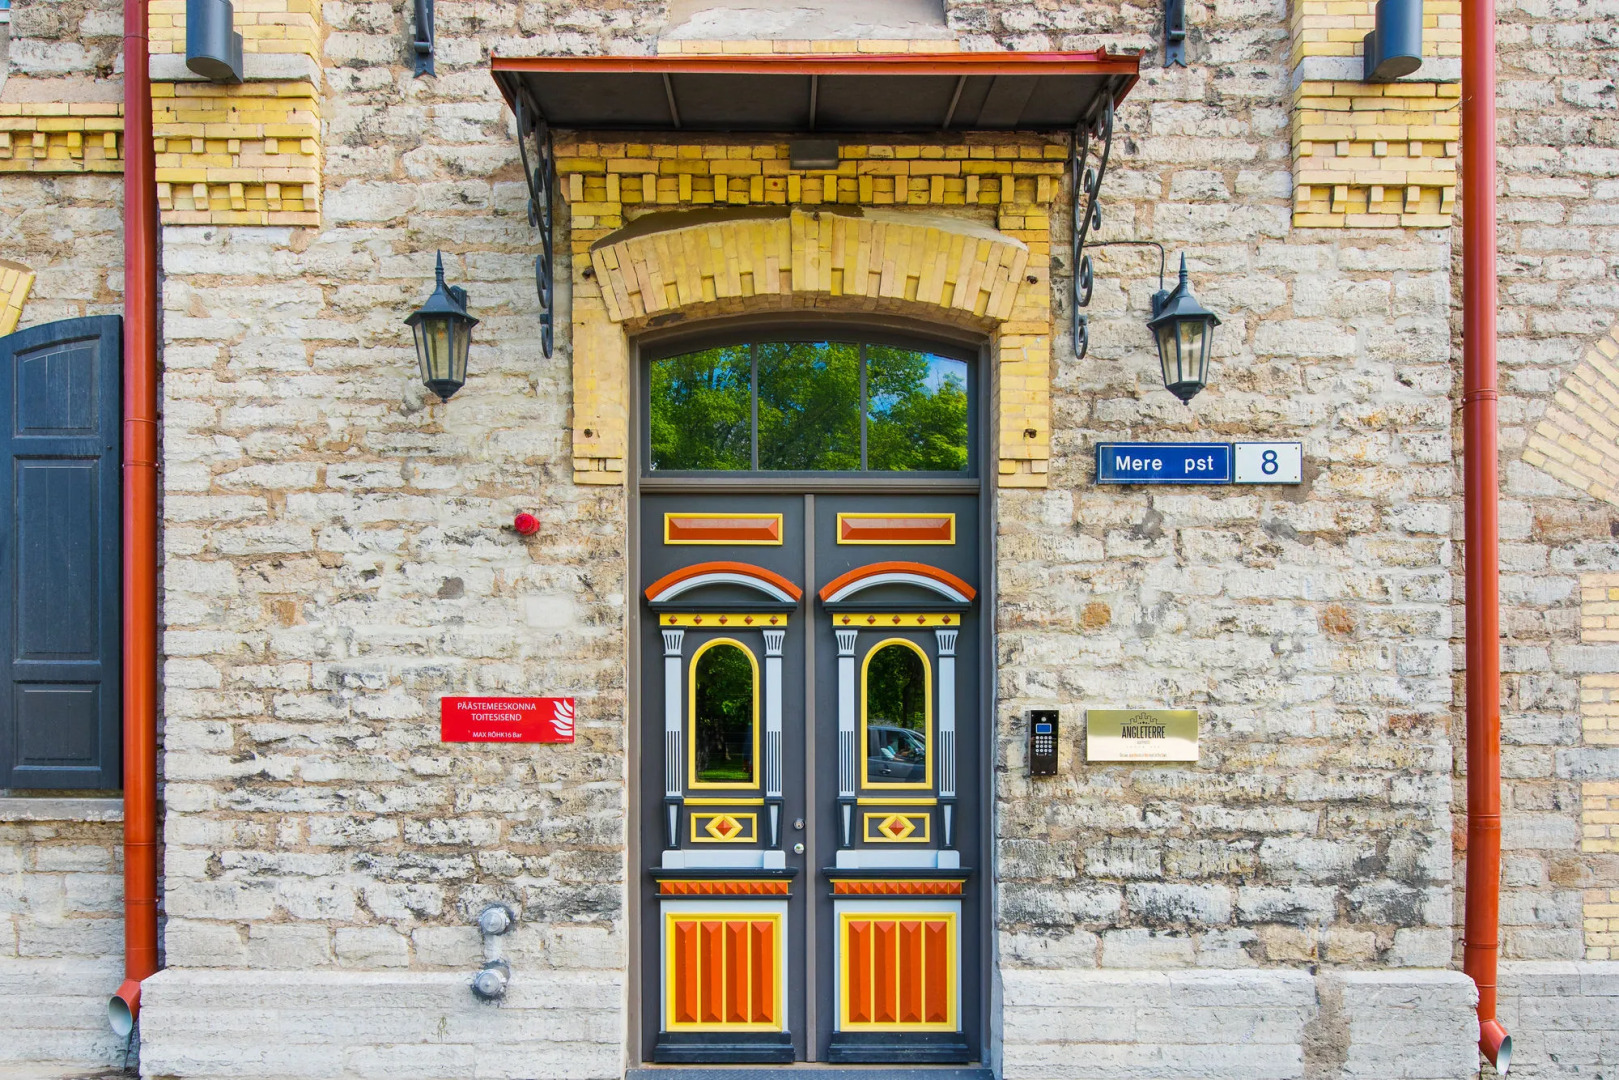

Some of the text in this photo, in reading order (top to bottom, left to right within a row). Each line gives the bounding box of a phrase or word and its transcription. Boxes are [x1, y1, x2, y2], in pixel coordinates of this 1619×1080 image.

[1116, 455, 1214, 474] Mere pst
[1261, 449, 1279, 475] 8
[457, 701, 537, 711] PÄÄSTEMEESKONNA
[471, 713, 522, 722] TOITESISEND
[1121, 726, 1166, 739] ANGLETERRE
